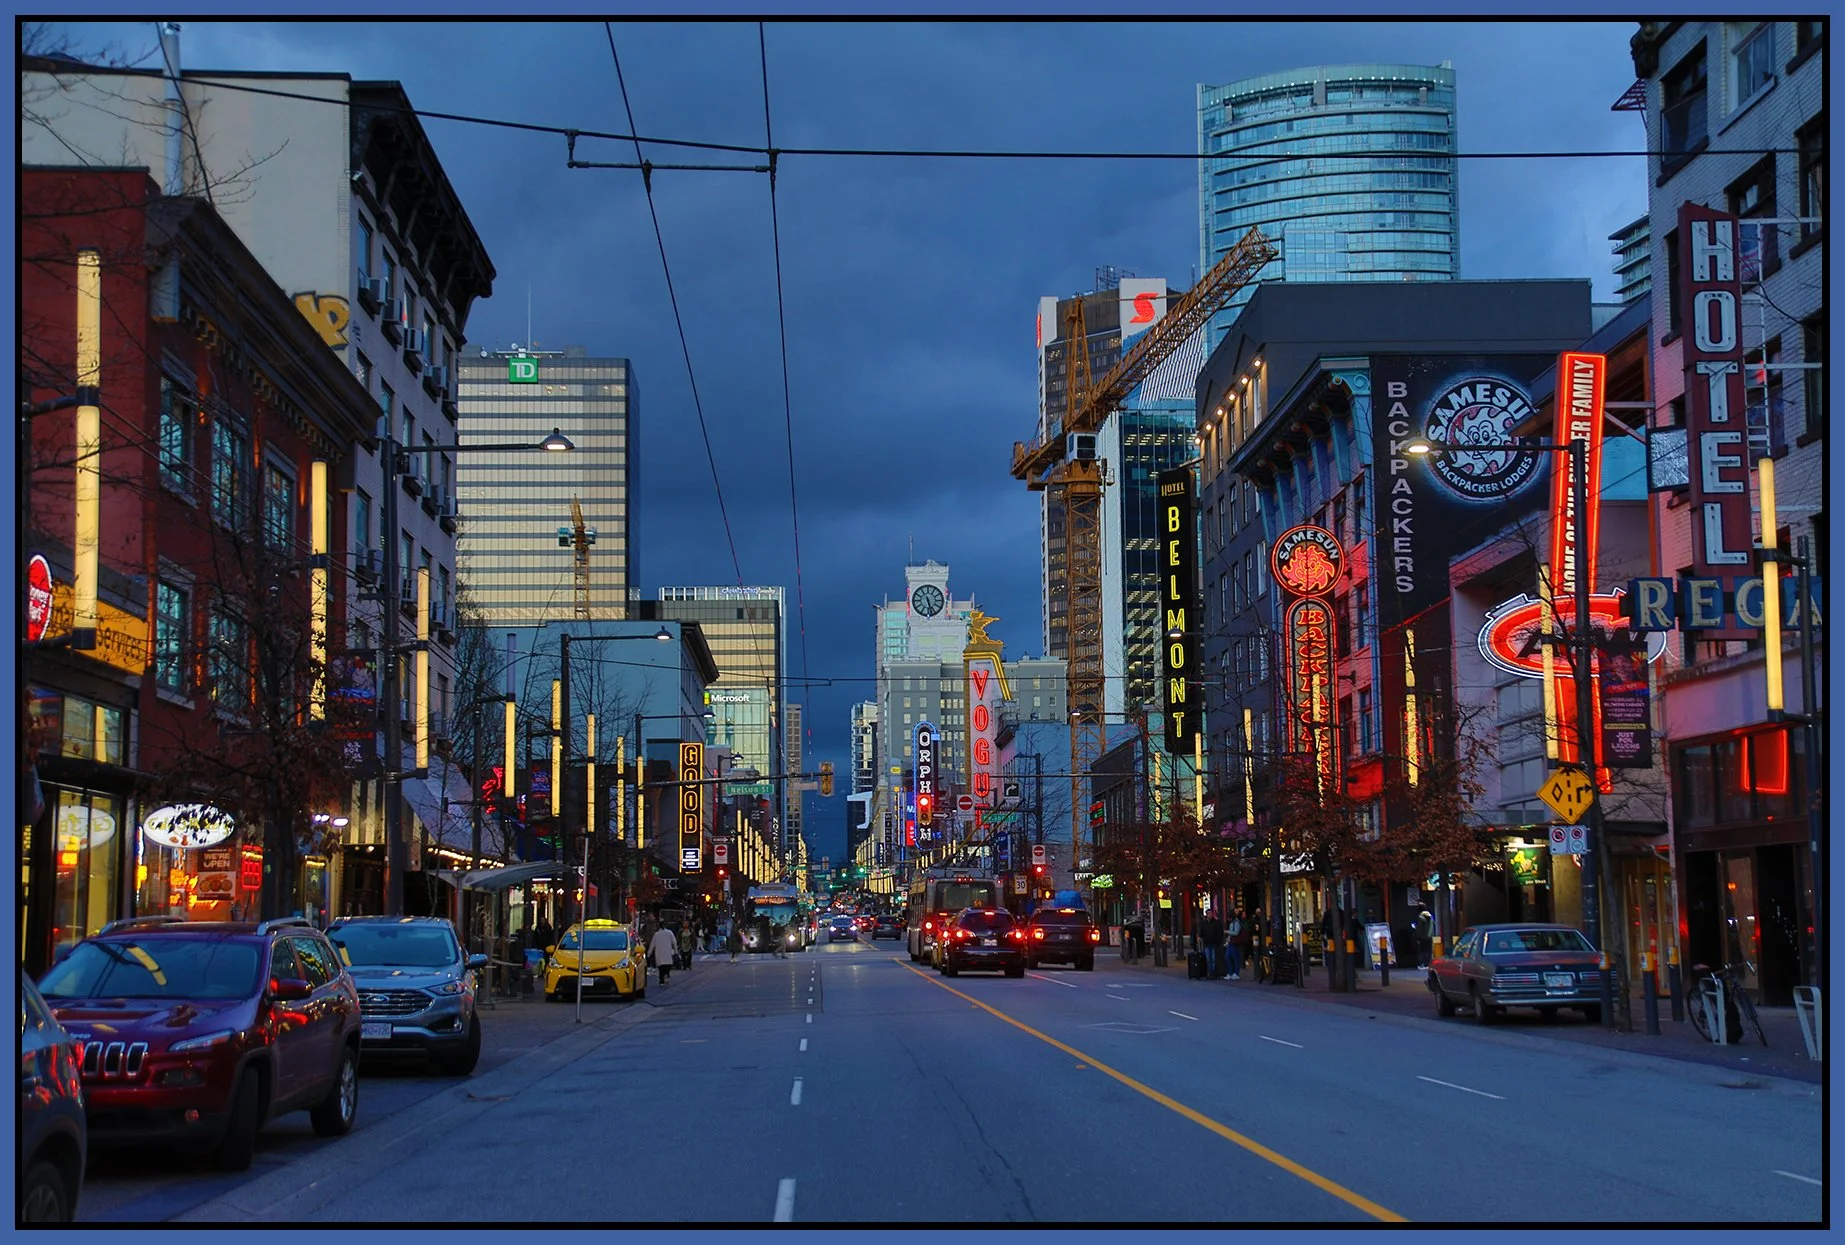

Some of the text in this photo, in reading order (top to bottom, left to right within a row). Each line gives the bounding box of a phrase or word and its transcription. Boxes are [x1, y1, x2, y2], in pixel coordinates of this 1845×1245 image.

[511, 362, 535, 378] TD
[1572, 359, 1595, 416] FAMILY
[1690, 220, 1748, 566] HOTEL
[1428, 383, 1531, 442] SAMESU
[1161, 482, 1185, 497] HOTEL
[1387, 381, 1415, 593] BACKPACKERS
[1436, 457, 1533, 493] BACKPACKER LODGES
[1279, 530, 1340, 561] SAMESUN
[1167, 506, 1185, 738] BELMONT
[711, 693, 750, 702] Microsoft
[684, 745, 698, 834] GOOD
[730, 785, 770, 794] Nelson St
[1016, 881, 1026, 889] 30
